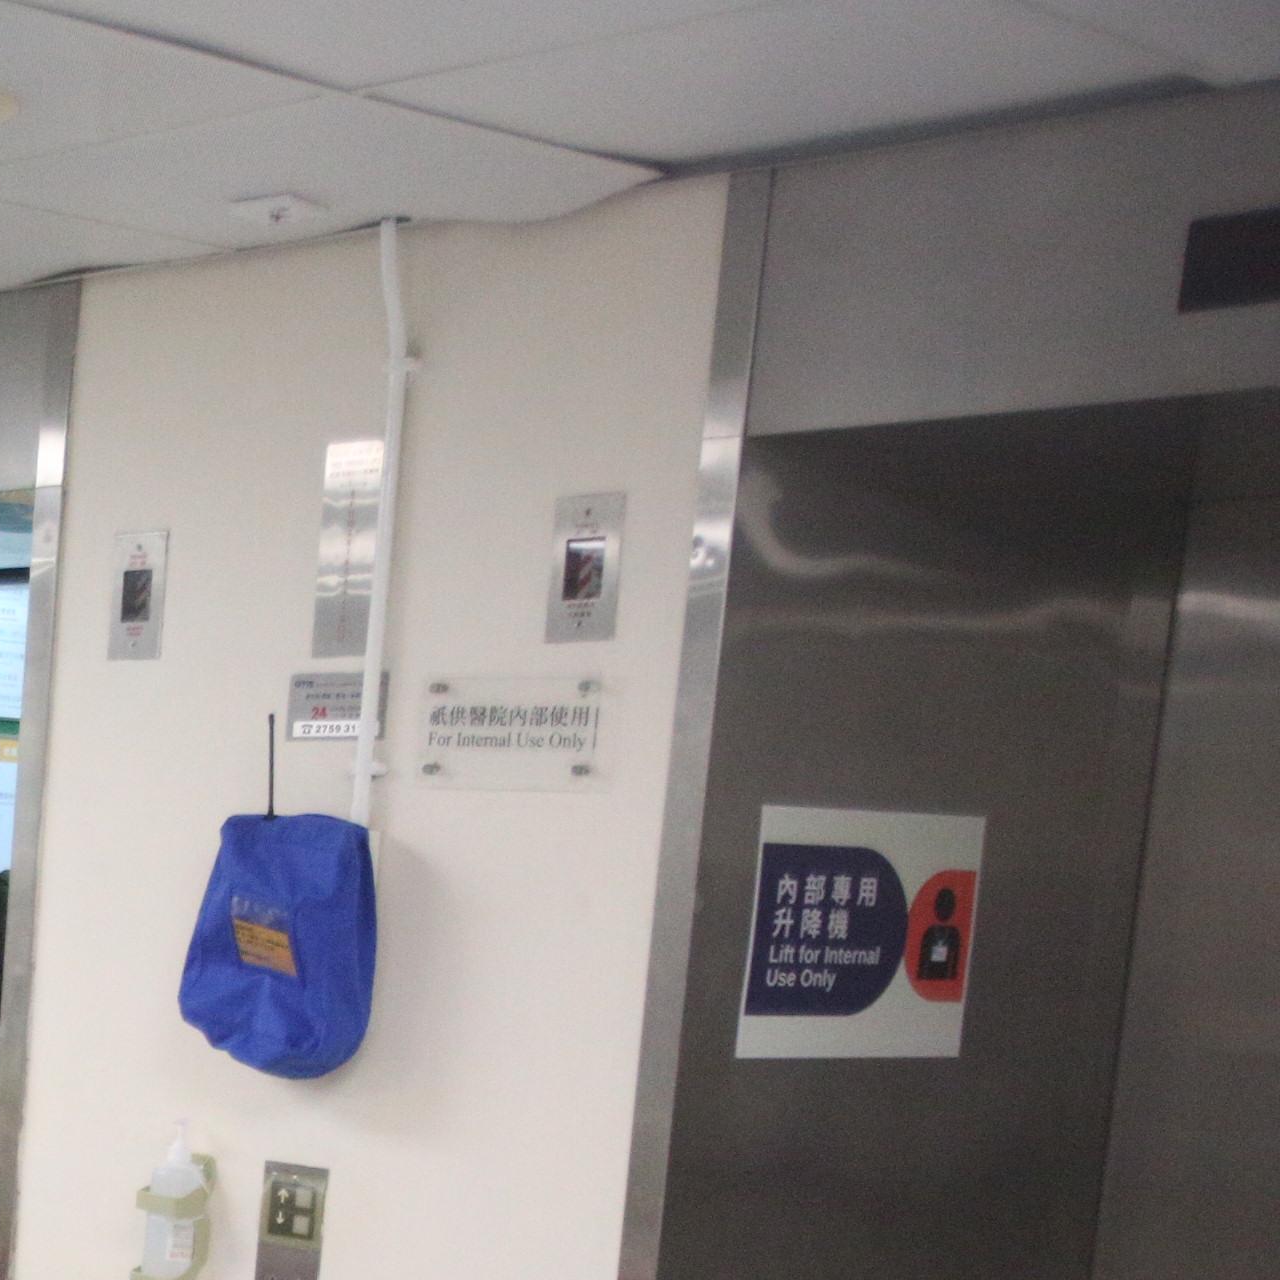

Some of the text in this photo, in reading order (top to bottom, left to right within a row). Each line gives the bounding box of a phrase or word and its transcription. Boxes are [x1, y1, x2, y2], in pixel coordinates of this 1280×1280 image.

[315, 723, 341, 734] 2759
[427, 732, 586, 751] For Internal Use Only
[772, 908, 850, 940] 升降機
[768, 945, 881, 965] Lift for Internal
[766, 969, 836, 992] Use Only
